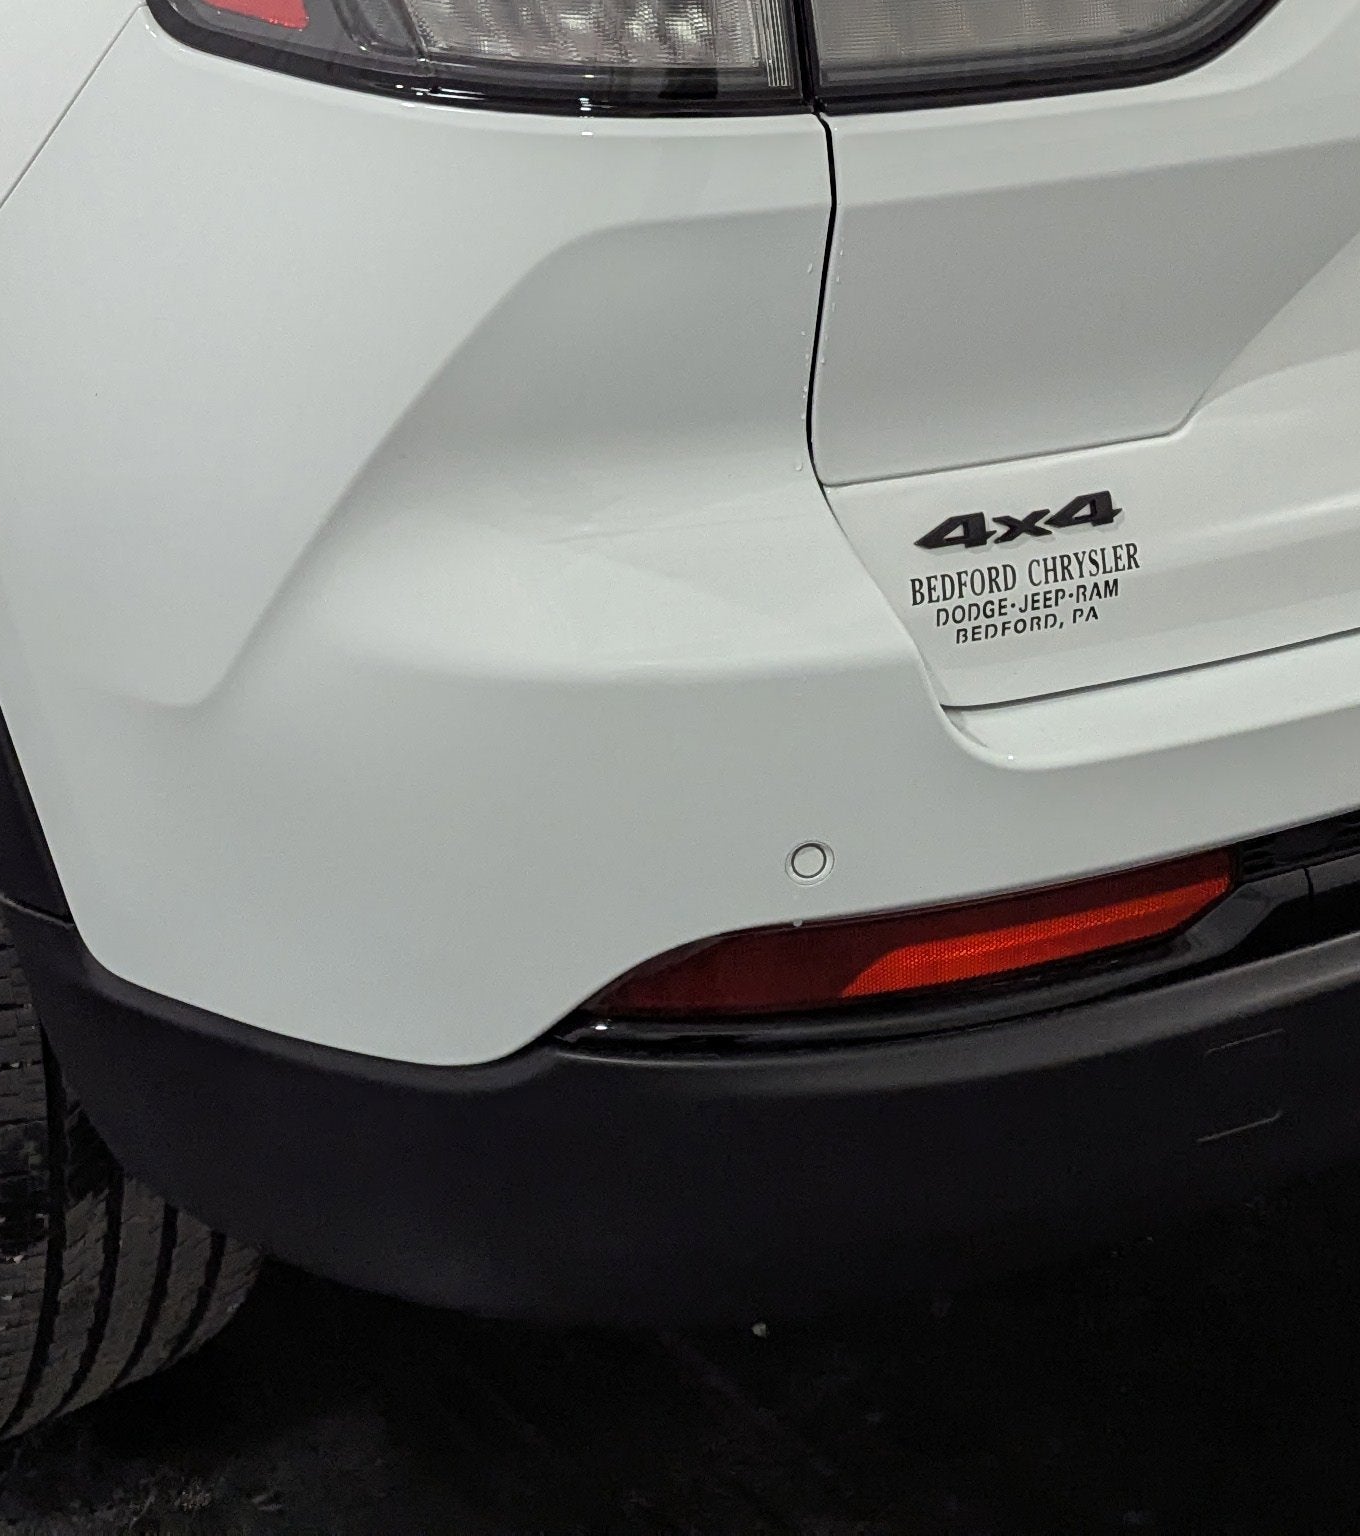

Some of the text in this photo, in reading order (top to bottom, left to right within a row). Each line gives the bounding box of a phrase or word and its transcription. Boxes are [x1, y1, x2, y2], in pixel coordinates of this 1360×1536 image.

[913, 490, 1123, 549] 4x4
[909, 542, 1141, 606] BEDFORD CHRYSLER
[955, 605, 1100, 644] BEDFORD, PA
